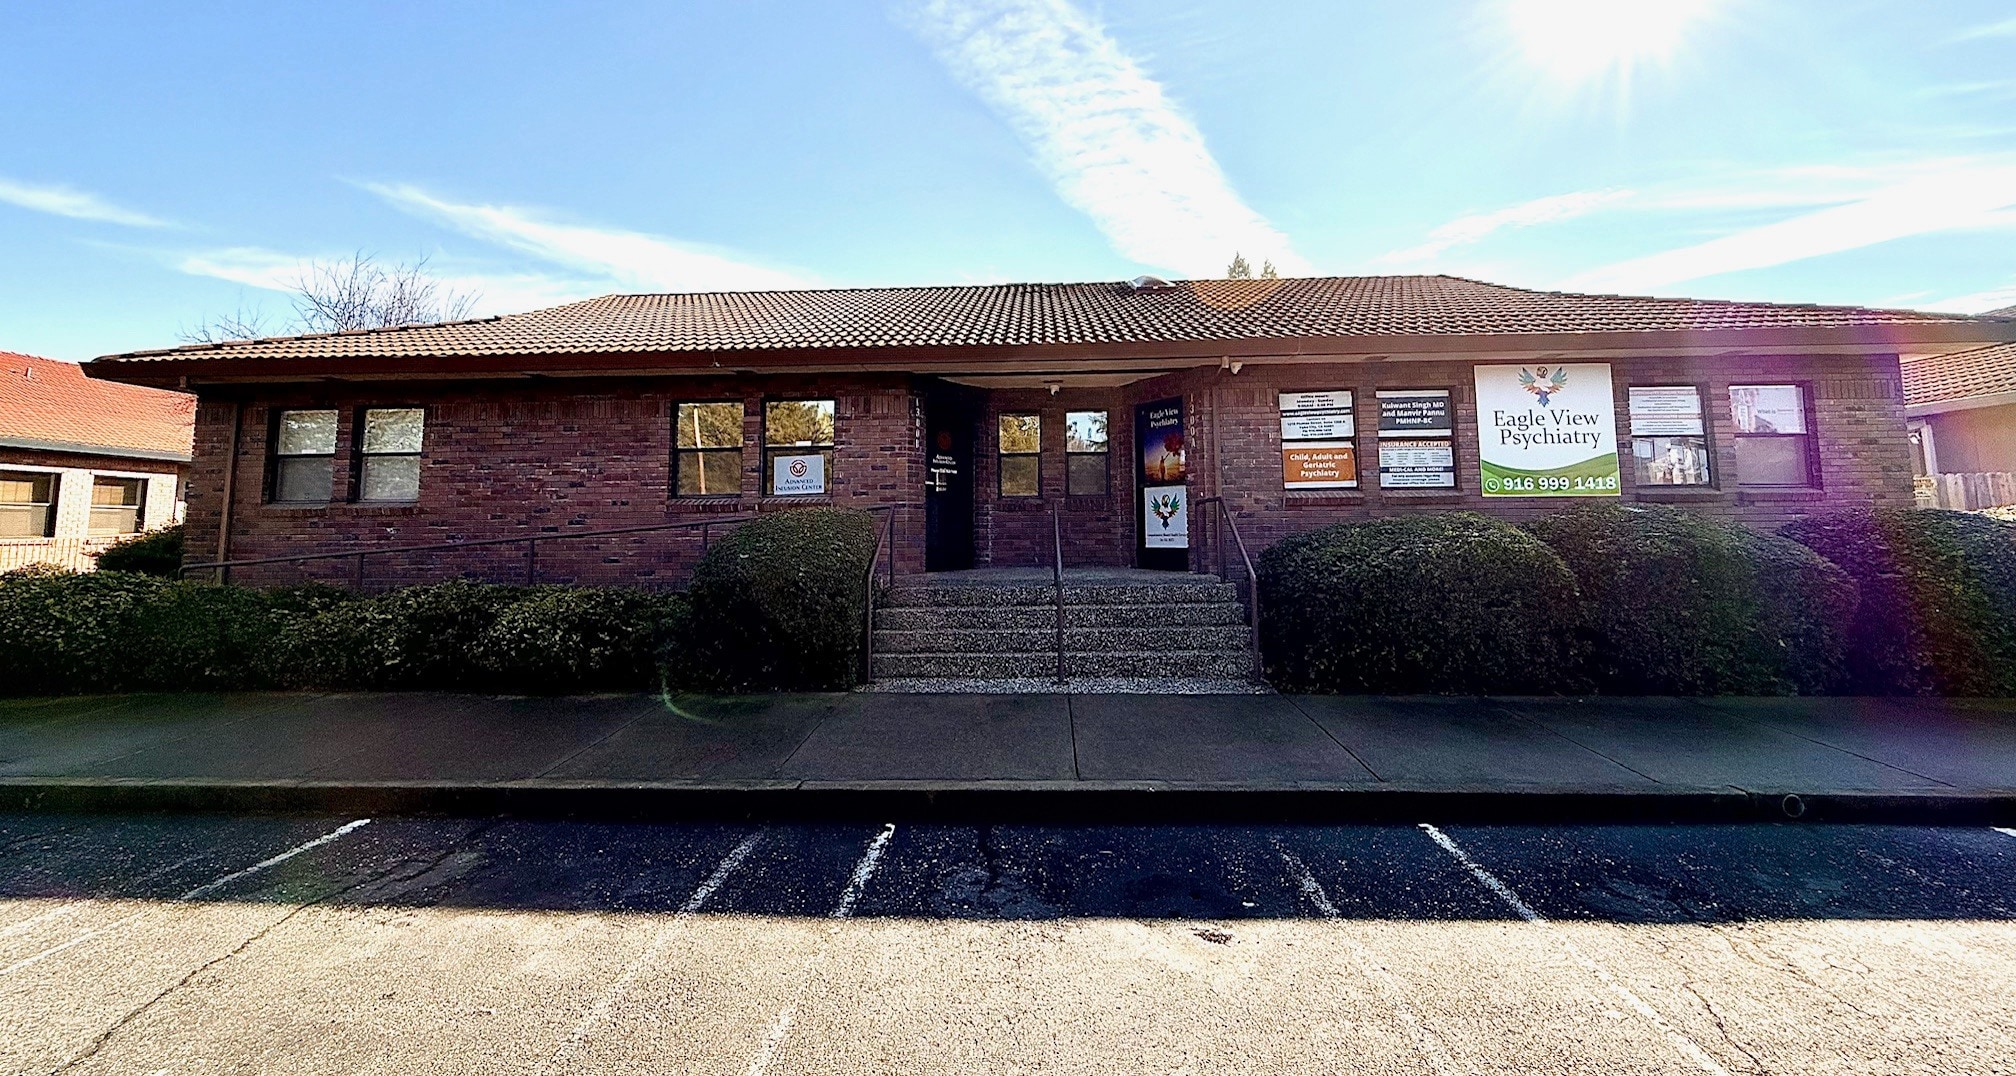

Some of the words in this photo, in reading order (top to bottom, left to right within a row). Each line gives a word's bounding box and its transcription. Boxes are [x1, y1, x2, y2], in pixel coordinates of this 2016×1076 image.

[1494, 409, 1545, 431] Eagle
[1550, 409, 1599, 426] View
[1500, 428, 1601, 449] Psychiatry
[1300, 470, 1339, 478] Psychiatry
[1503, 477, 1534, 490] 916
[1538, 477, 1570, 490] 999
[1574, 476, 1617, 490] 1418
